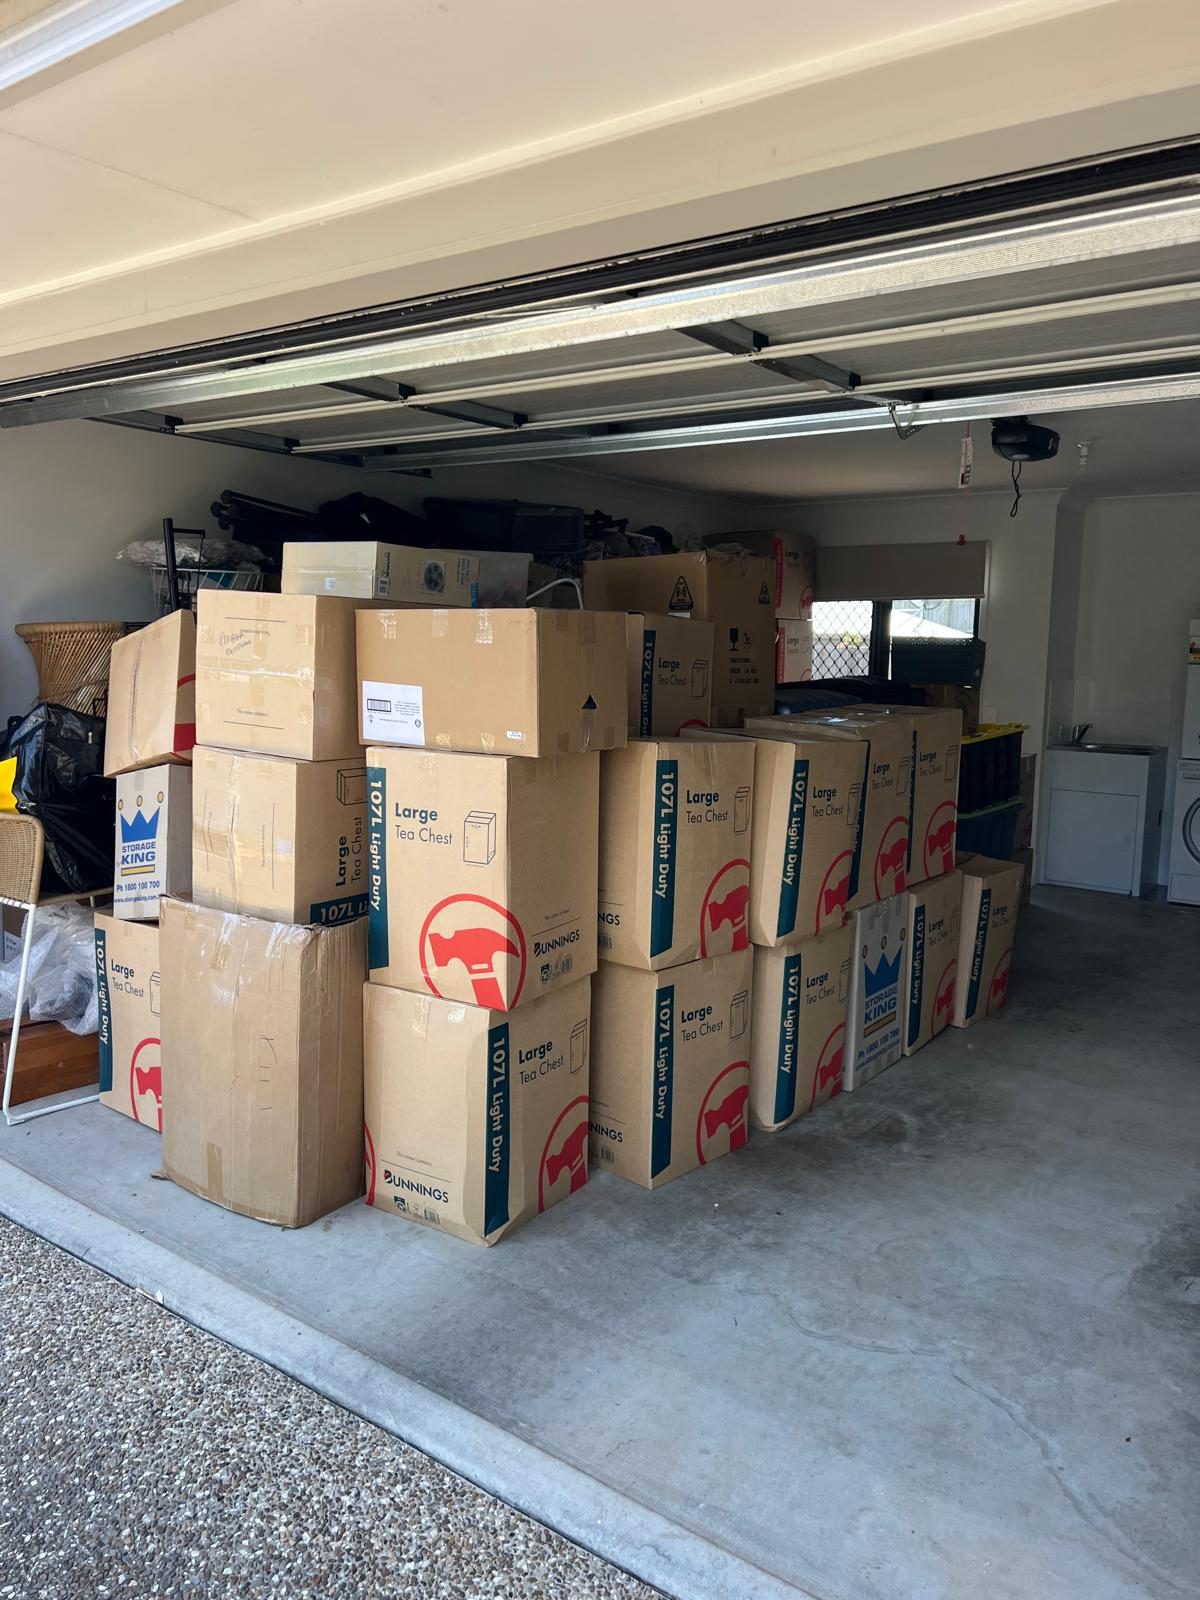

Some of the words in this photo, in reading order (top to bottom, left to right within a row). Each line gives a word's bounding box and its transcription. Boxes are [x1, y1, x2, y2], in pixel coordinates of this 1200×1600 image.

[658, 657, 680, 672] Large
[658, 674, 668, 685] Tea
[873, 762, 890, 775] Large
[919, 750, 937, 763] Large
[370, 780, 382, 827] 107L
[660, 772, 675, 818] 107L
[686, 789, 720, 805] Large
[793, 770, 807, 812] 107L
[812, 785, 837, 801] Large
[394, 802, 438, 823] Large
[686, 810, 702, 824] Tea
[705, 808, 729, 823] Chest
[811, 804, 824, 818] Tea
[826, 803, 844, 817] Chest
[122, 841, 156, 853] STORAGE
[352, 816, 362, 857] Chest
[394, 824, 416, 842] Tea
[418, 827, 453, 846] Chest
[657, 822, 671, 860] Light
[788, 816, 801, 850] Light
[121, 851, 156, 865] KING
[335, 835, 349, 887] Large
[369, 831, 381, 874] Light
[351, 859, 362, 882] Tea
[655, 863, 670, 899] Duty
[783, 853, 797, 886] Duty
[116, 883, 124, 893] Ph
[125, 882, 137, 892] 1800
[138, 881, 148, 890] 100
[149, 880, 160, 889] 700
[371, 875, 381, 912] Duty
[321, 901, 353, 923] 107L
[928, 918, 944, 934] Large
[979, 897, 989, 928] 107L
[534, 928, 581, 958] BUNNINGS
[915, 913, 925, 951] 107L
[96, 939, 105, 978] 107L
[111, 958, 135, 978] Large
[112, 976, 124, 992] Tea
[124, 982, 144, 998] Chest
[787, 966, 800, 1007] 107L
[806, 971, 829, 989] Large
[806, 993, 818, 1005] Tea
[818, 985, 836, 1000] Chest
[98, 980, 108, 1013] Light
[864, 997, 897, 1024] KING
[865, 985, 898, 1009] STORAGE
[659, 997, 671, 1043] 107L
[681, 1004, 713, 1024] Large
[783, 1009, 797, 1041] Light
[99, 1015, 108, 1046] Duty
[682, 1029, 697, 1042] Tea
[699, 1020, 723, 1037] Chest
[491, 1037, 506, 1088] 107L
[518, 1040, 553, 1064] Large
[656, 1046, 668, 1085] Light
[780, 1043, 794, 1074] Duty
[519, 1069, 536, 1085] Tea
[539, 1055, 564, 1077] Chest
[489, 1091, 504, 1133] Light
[655, 1086, 668, 1120] Duty
[488, 1135, 503, 1173] Duty
[384, 1168, 449, 1203] BUNNINGS
